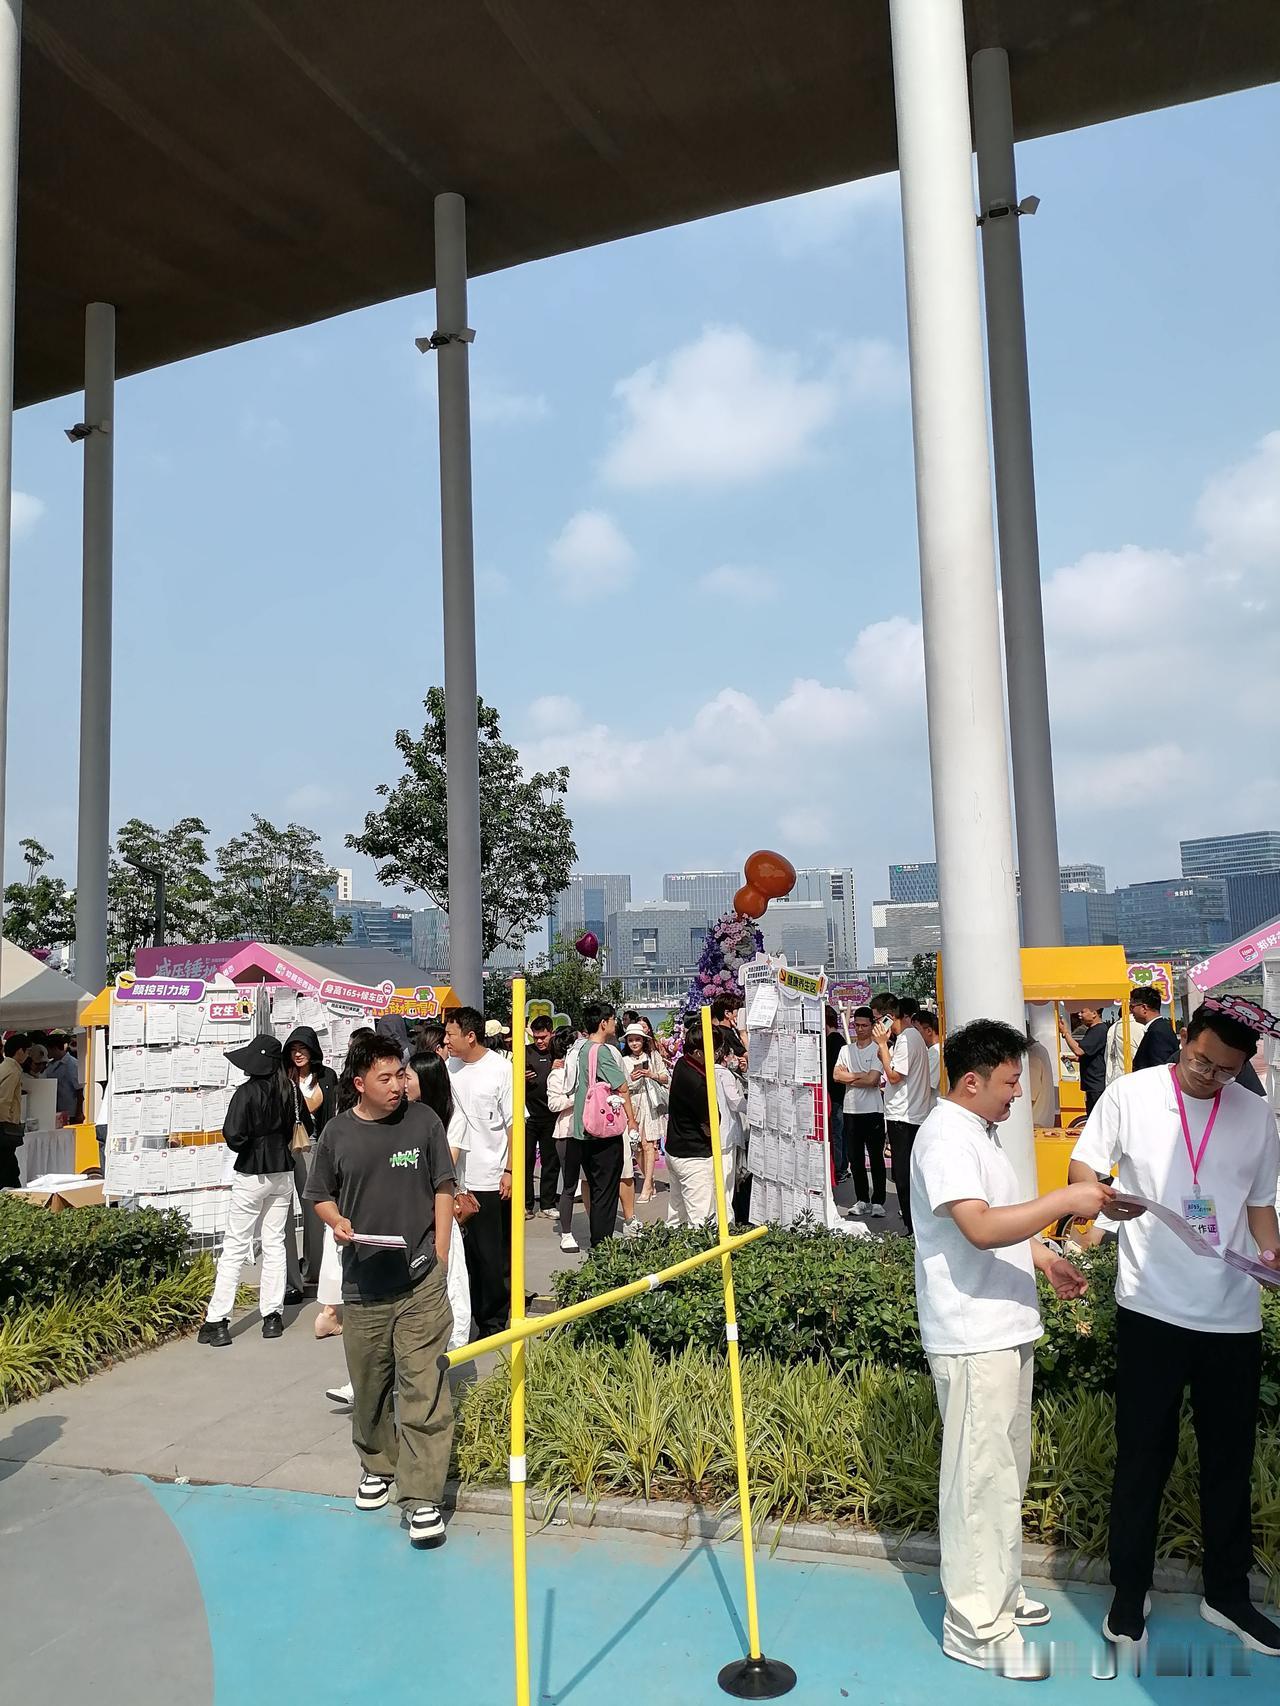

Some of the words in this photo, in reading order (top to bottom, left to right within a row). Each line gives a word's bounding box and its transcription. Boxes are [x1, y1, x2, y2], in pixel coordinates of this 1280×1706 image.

[132, 984, 191, 996] 颜控引力场
[787, 974, 817, 993] 健康养生区
[324, 984, 385, 1004] 身高165+候车区
[211, 1005, 235, 1017] 女生
